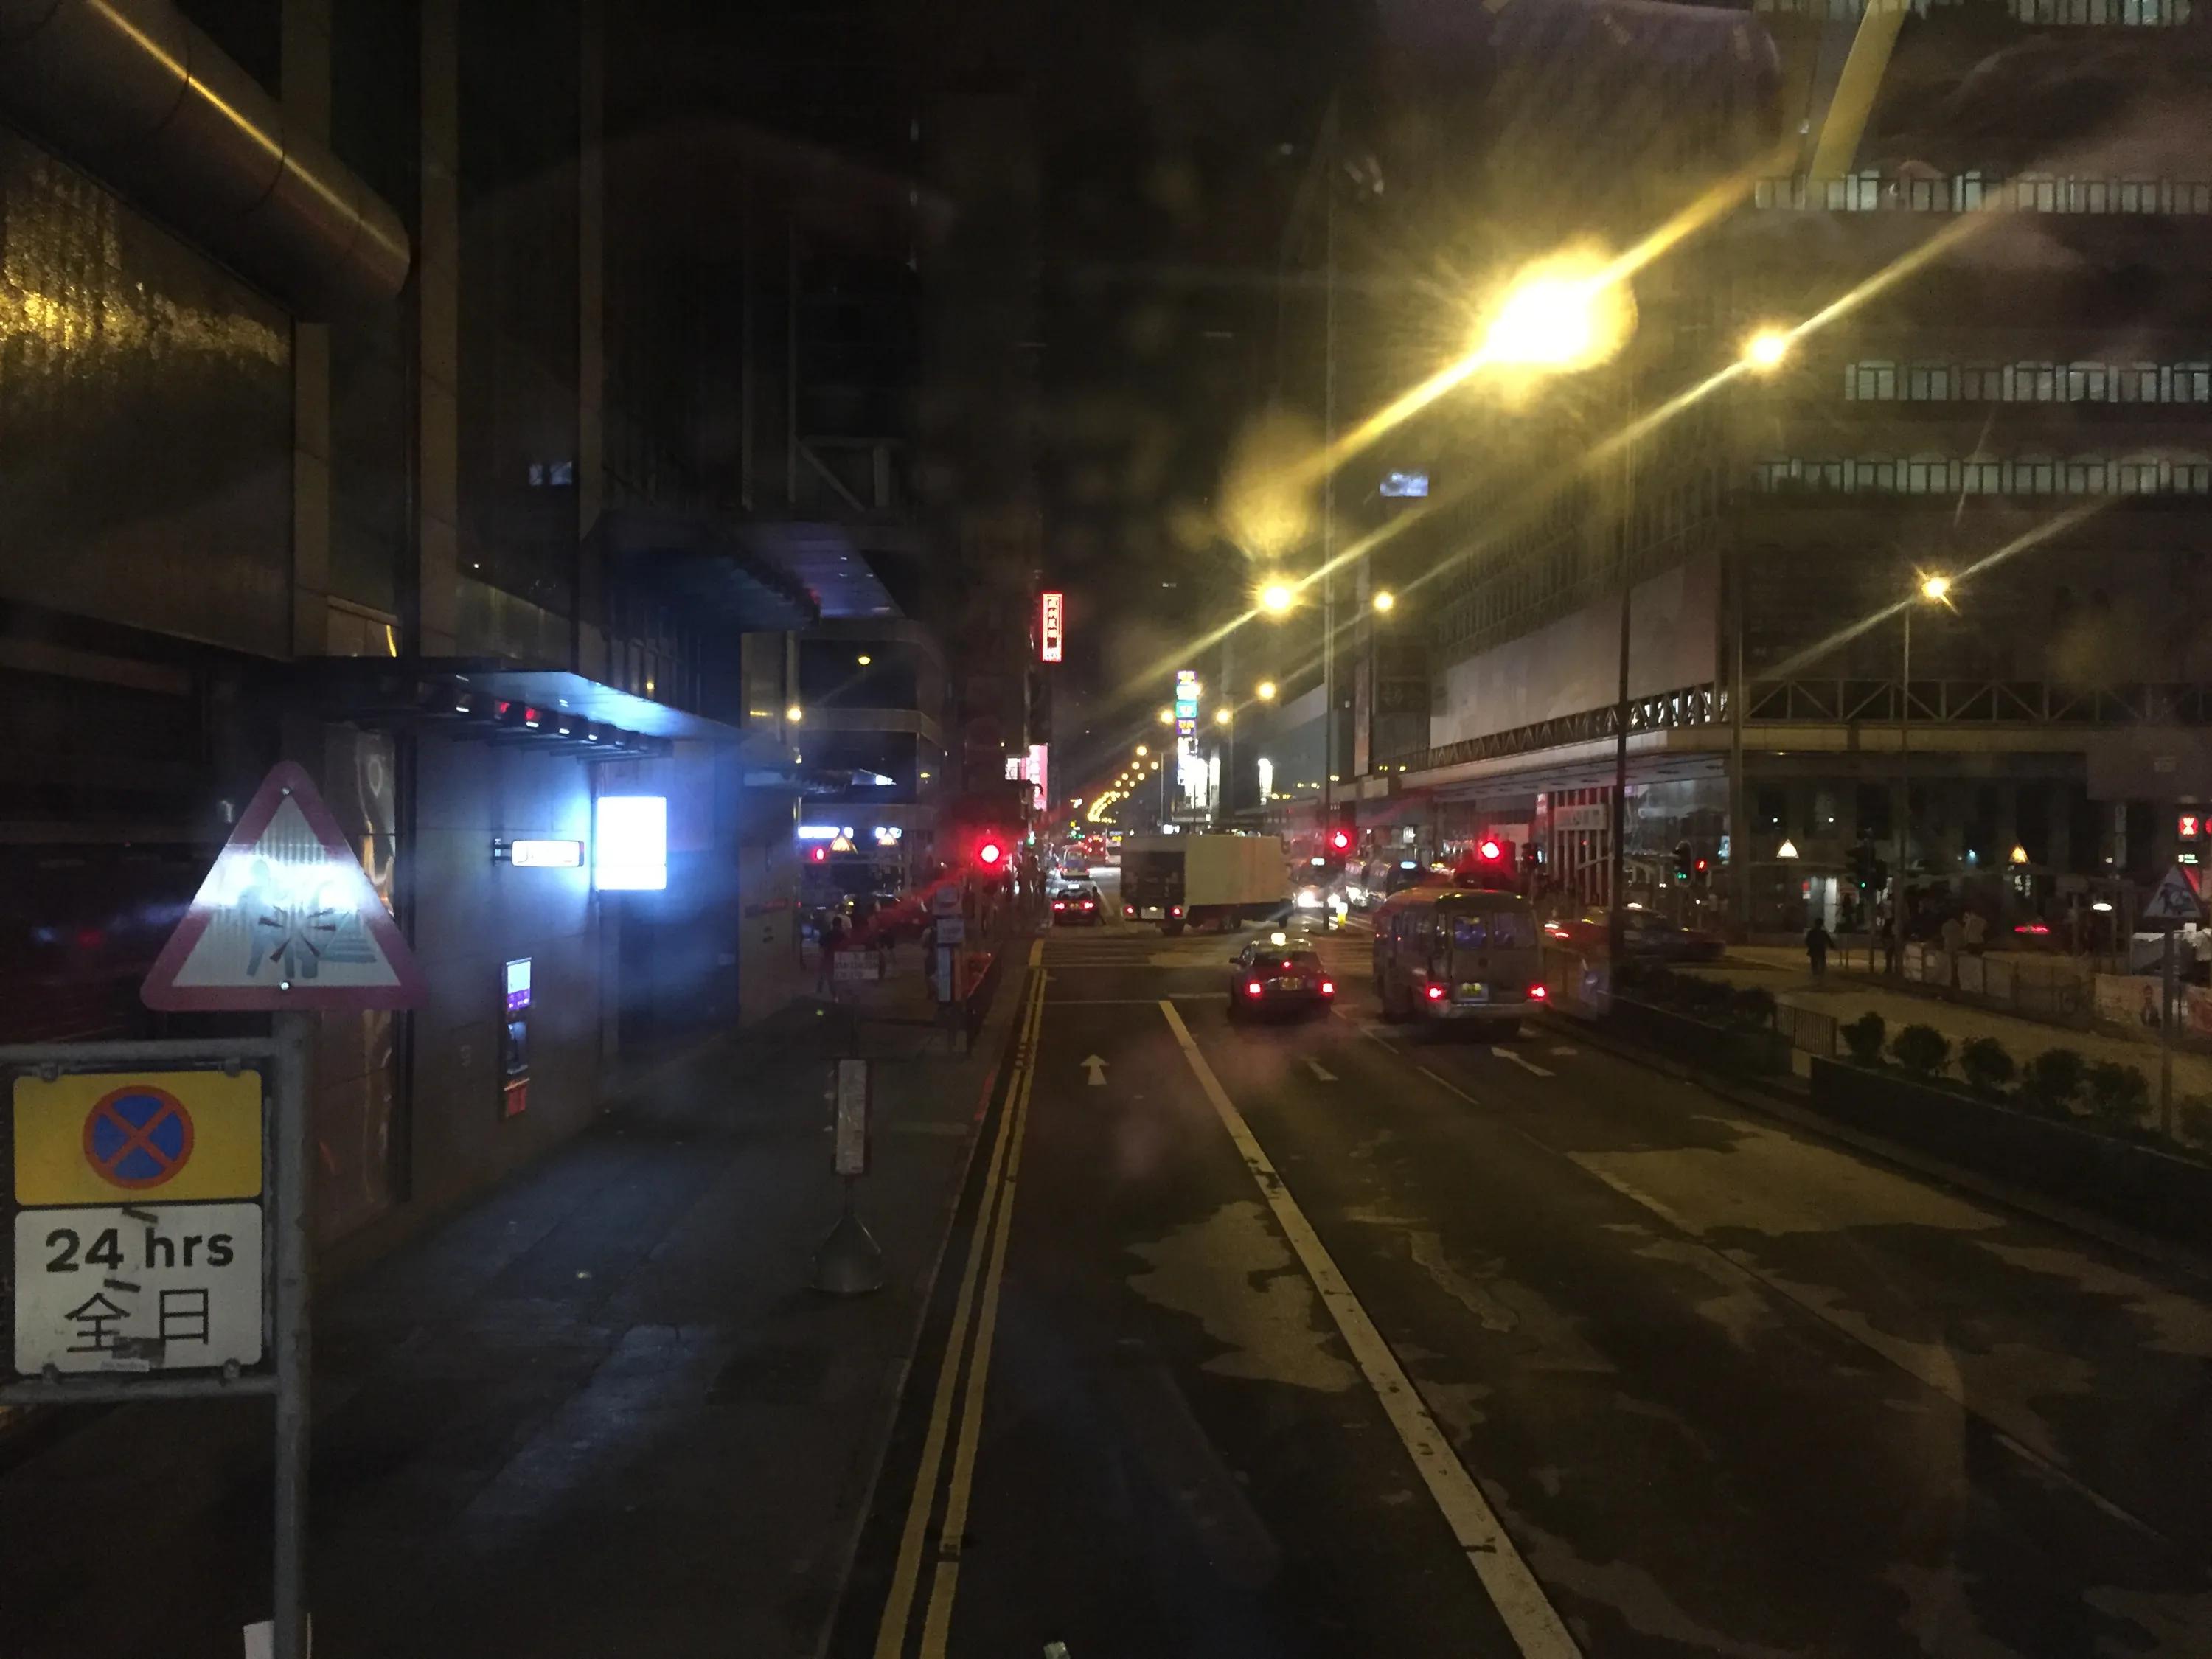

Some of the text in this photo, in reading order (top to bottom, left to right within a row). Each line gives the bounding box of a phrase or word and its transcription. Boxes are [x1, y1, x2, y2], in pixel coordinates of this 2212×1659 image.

[46, 1226, 234, 1273] 24 hrs
[65, 1289, 209, 1353] 全日
